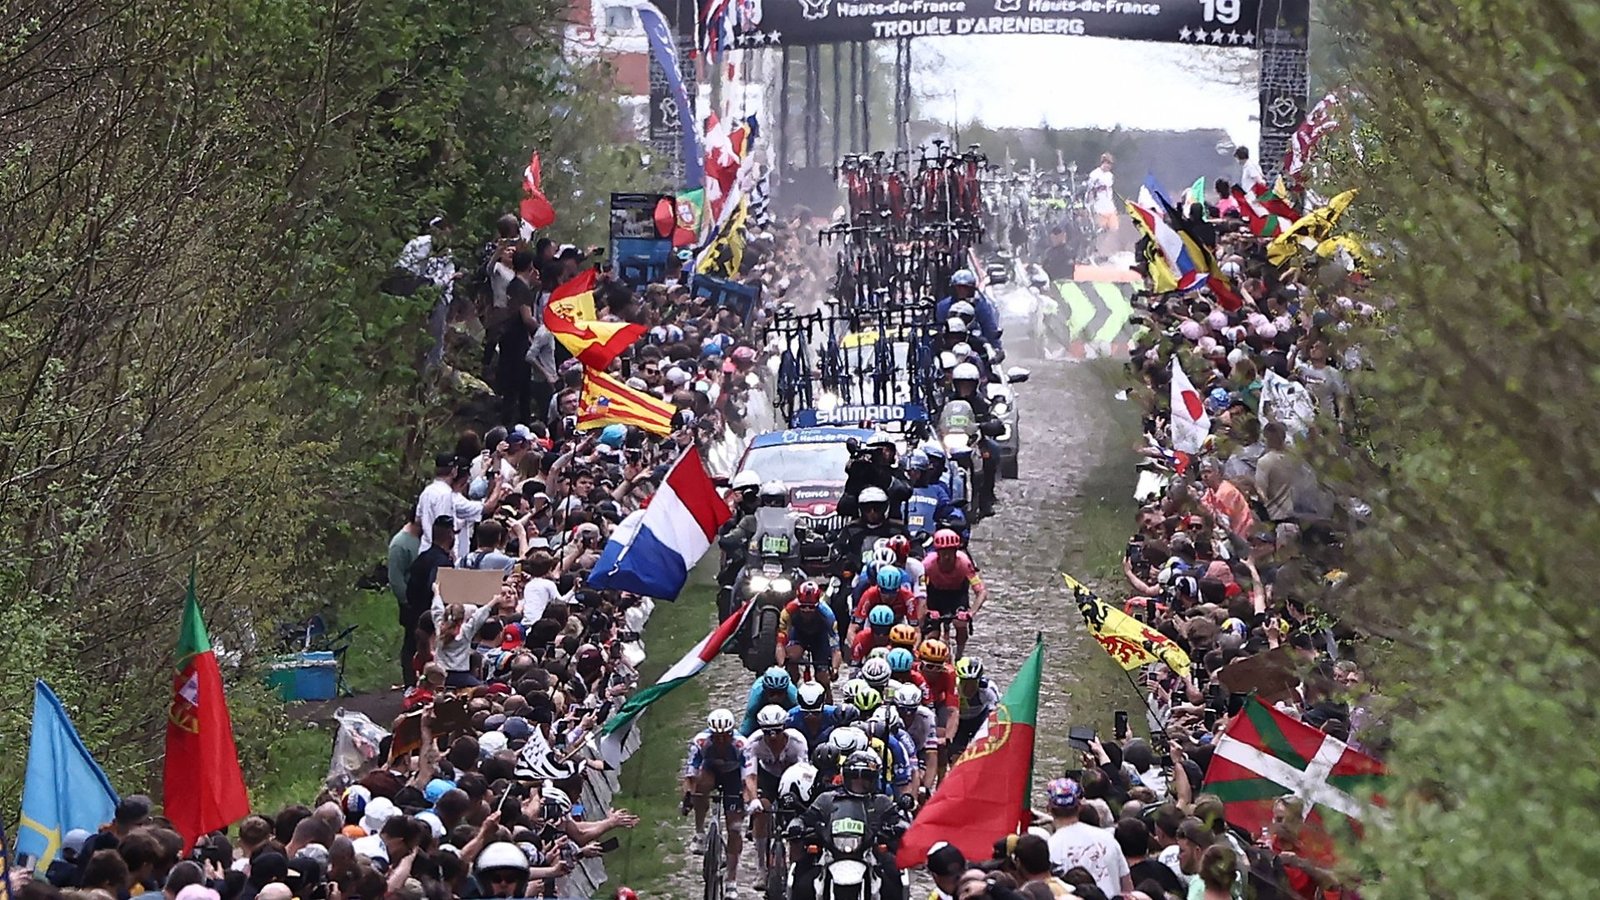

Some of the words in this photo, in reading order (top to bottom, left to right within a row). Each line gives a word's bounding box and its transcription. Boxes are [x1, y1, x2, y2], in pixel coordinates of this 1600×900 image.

[836, 1, 967, 18] Hauts-de-France
[1028, 0, 1161, 16] Hauts-de-France
[1203, 0, 1241, 24] 19
[956, 16, 1085, 35] D'ARENBERG
[815, 405, 904, 425] SHIMANO
